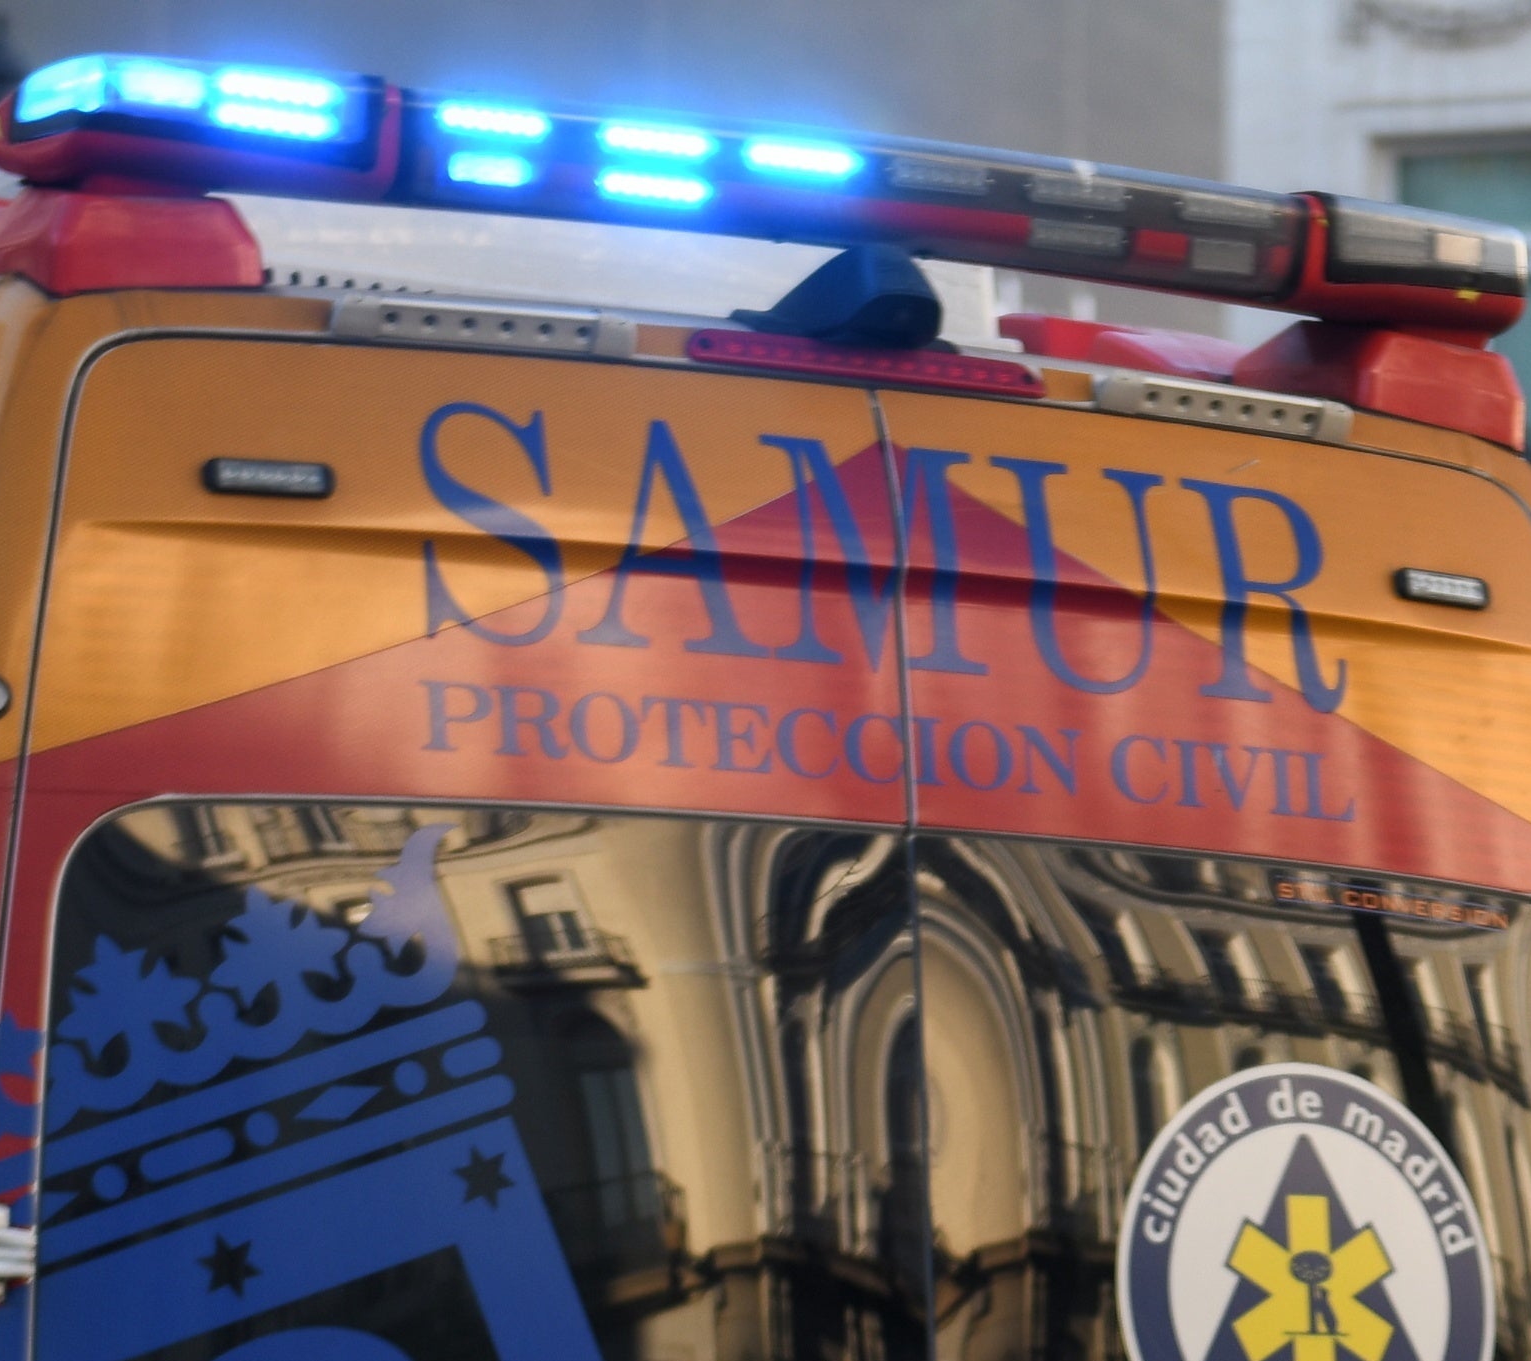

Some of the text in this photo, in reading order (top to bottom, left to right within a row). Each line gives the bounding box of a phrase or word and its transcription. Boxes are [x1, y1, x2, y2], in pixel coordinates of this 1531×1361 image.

[418, 401, 1347, 714] SAMUR
[418, 679, 1356, 823] PROTECCION CIVIL
[1141, 1078, 1476, 1257] ciudad de madrid
